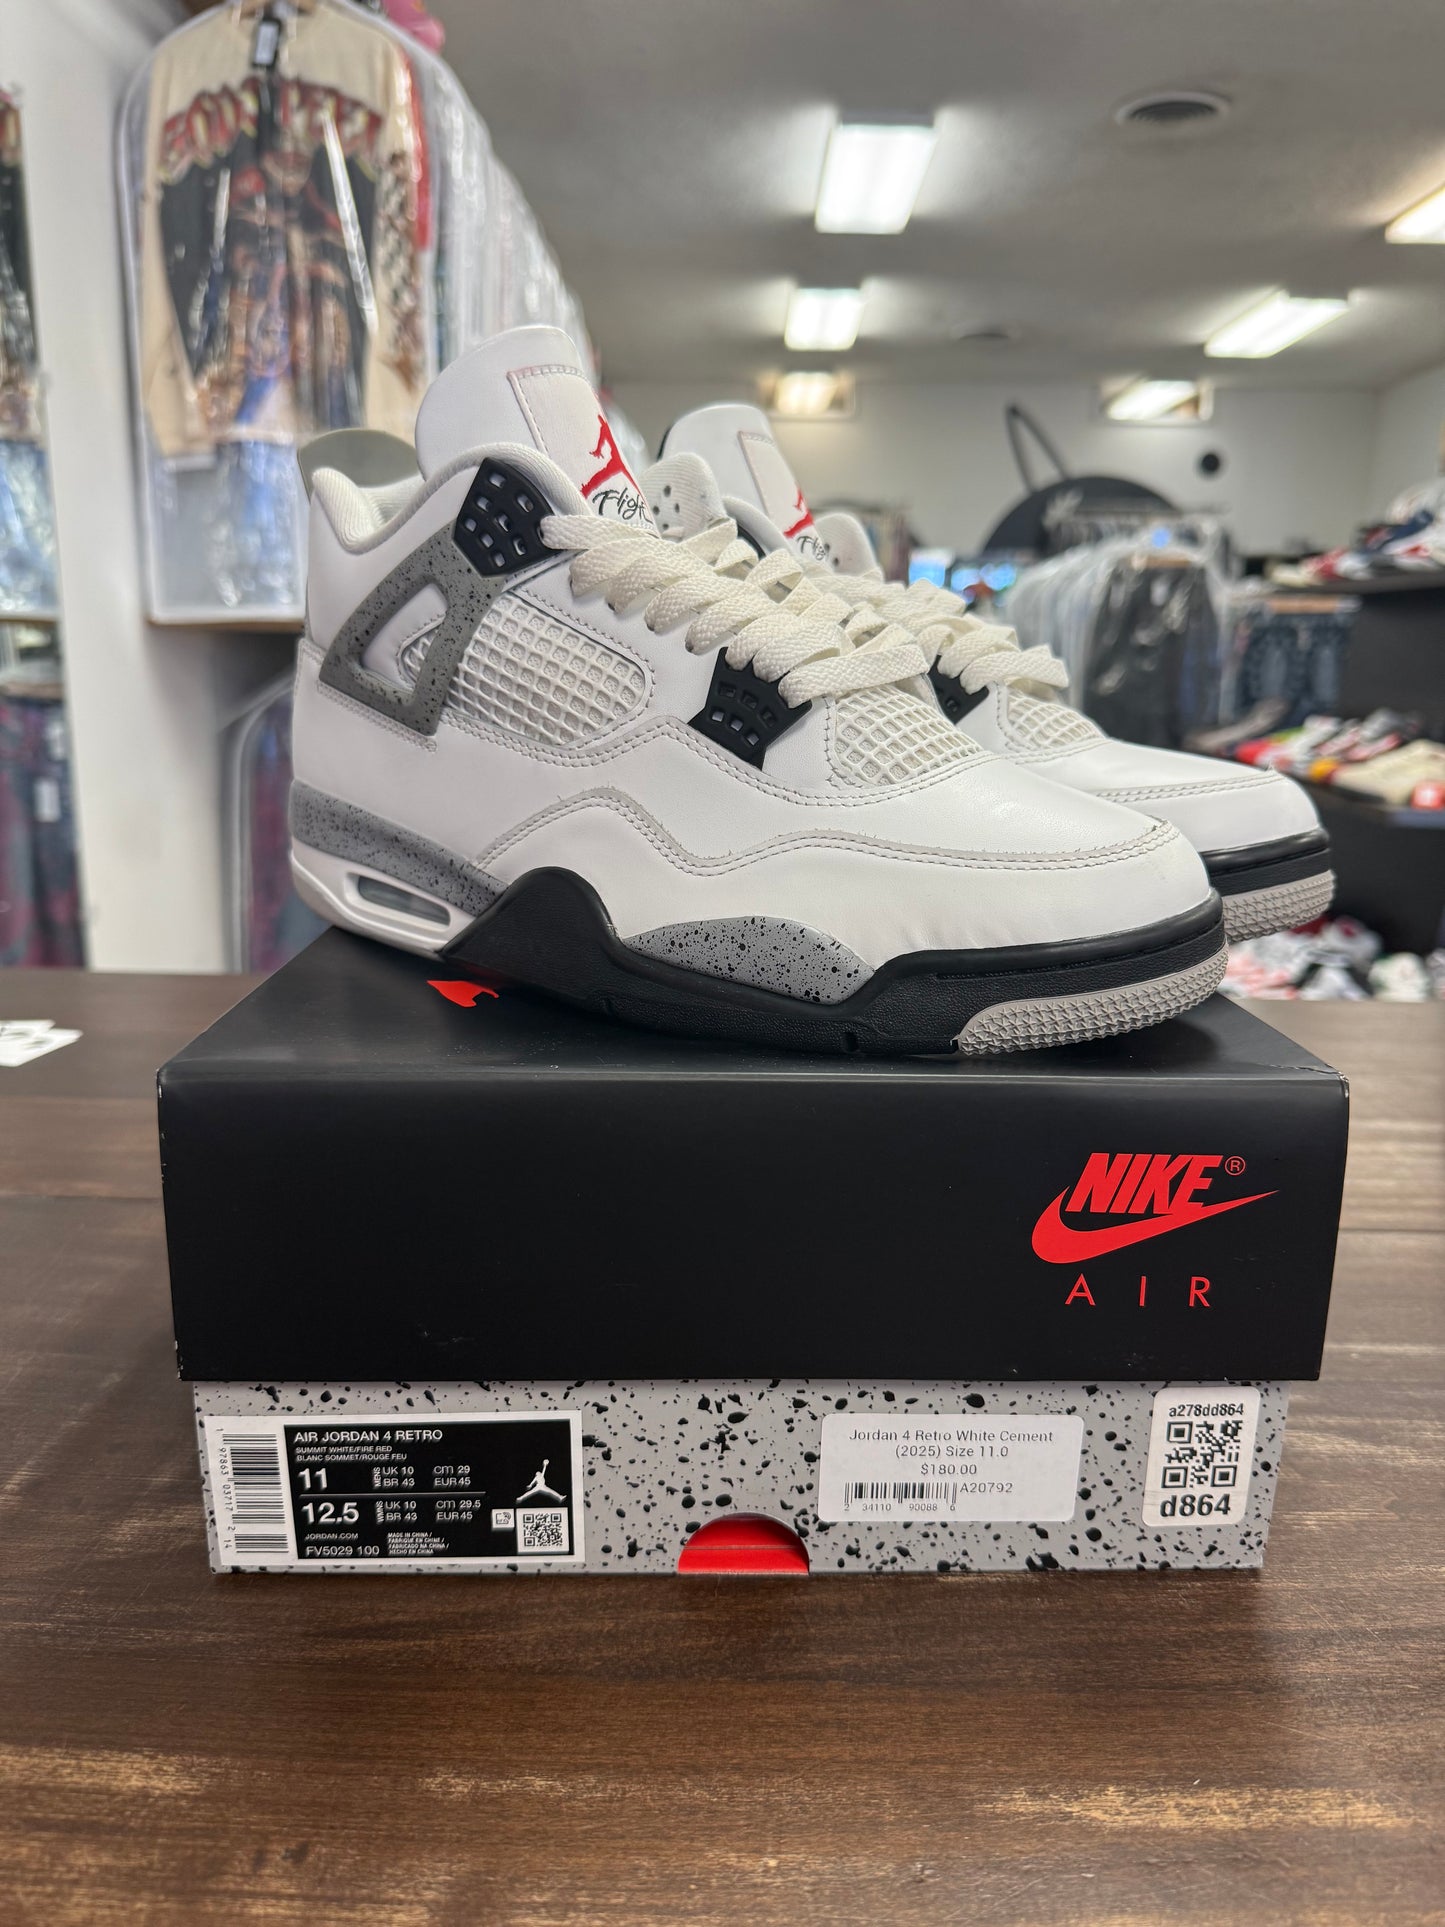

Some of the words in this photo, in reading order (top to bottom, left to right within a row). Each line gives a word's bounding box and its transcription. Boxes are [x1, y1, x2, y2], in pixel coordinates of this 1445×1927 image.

[1065, 1152, 1224, 1215] NIKE
[1065, 1273, 1211, 1308] AIR
[1168, 1402, 1245, 1418] a278dd864
[294, 1431, 319, 1442] AIR
[322, 1431, 380, 1442] JORDAN
[382, 1430, 392, 1441] 4
[395, 1429, 443, 1441] RETRO
[849, 1429, 898, 1442] Jordan
[902, 1431, 911, 1441] 4
[915, 1430, 952, 1442] Retro
[956, 1430, 996, 1442] White
[999, 1430, 1053, 1443] Cement
[296, 1446, 328, 1454] SUMMIT
[895, 1445, 942, 1459] (2025)
[945, 1445, 975, 1458] Size
[980, 1446, 1009, 1458] 11.0
[219, 1447, 229, 1476] 97863
[297, 1454, 324, 1462] BLANC
[382, 1466, 399, 1475] UK
[401, 1466, 415, 1475] 10
[457, 1465, 471, 1474] 29
[920, 1463, 978, 1476] $180.00
[298, 1467, 328, 1490] 11
[373, 1466, 382, 1487] MENS
[383, 1478, 399, 1486] BR
[401, 1477, 415, 1487] 43
[434, 1477, 457, 1486] EUR
[458, 1477, 471, 1485] 45
[959, 1482, 1013, 1494] A20792
[223, 1484, 234, 1512] 03717
[459, 1499, 482, 1508] 29.5
[385, 1501, 401, 1509] UK
[404, 1500, 417, 1509] 10
[843, 1503, 850, 1512] 2
[861, 1503, 892, 1512] 34110
[949, 1503, 956, 1512] 6
[1159, 1493, 1231, 1518] d864
[301, 1502, 360, 1523] 12.5
[375, 1500, 385, 1523] WMNS
[386, 1512, 402, 1521] BR
[404, 1512, 418, 1521] 43
[437, 1511, 459, 1520] EUR
[460, 1511, 473, 1520] 45
[304, 1532, 359, 1541] JORDAN.COM
[306, 1545, 354, 1556] FV5029
[356, 1545, 380, 1555] 100
